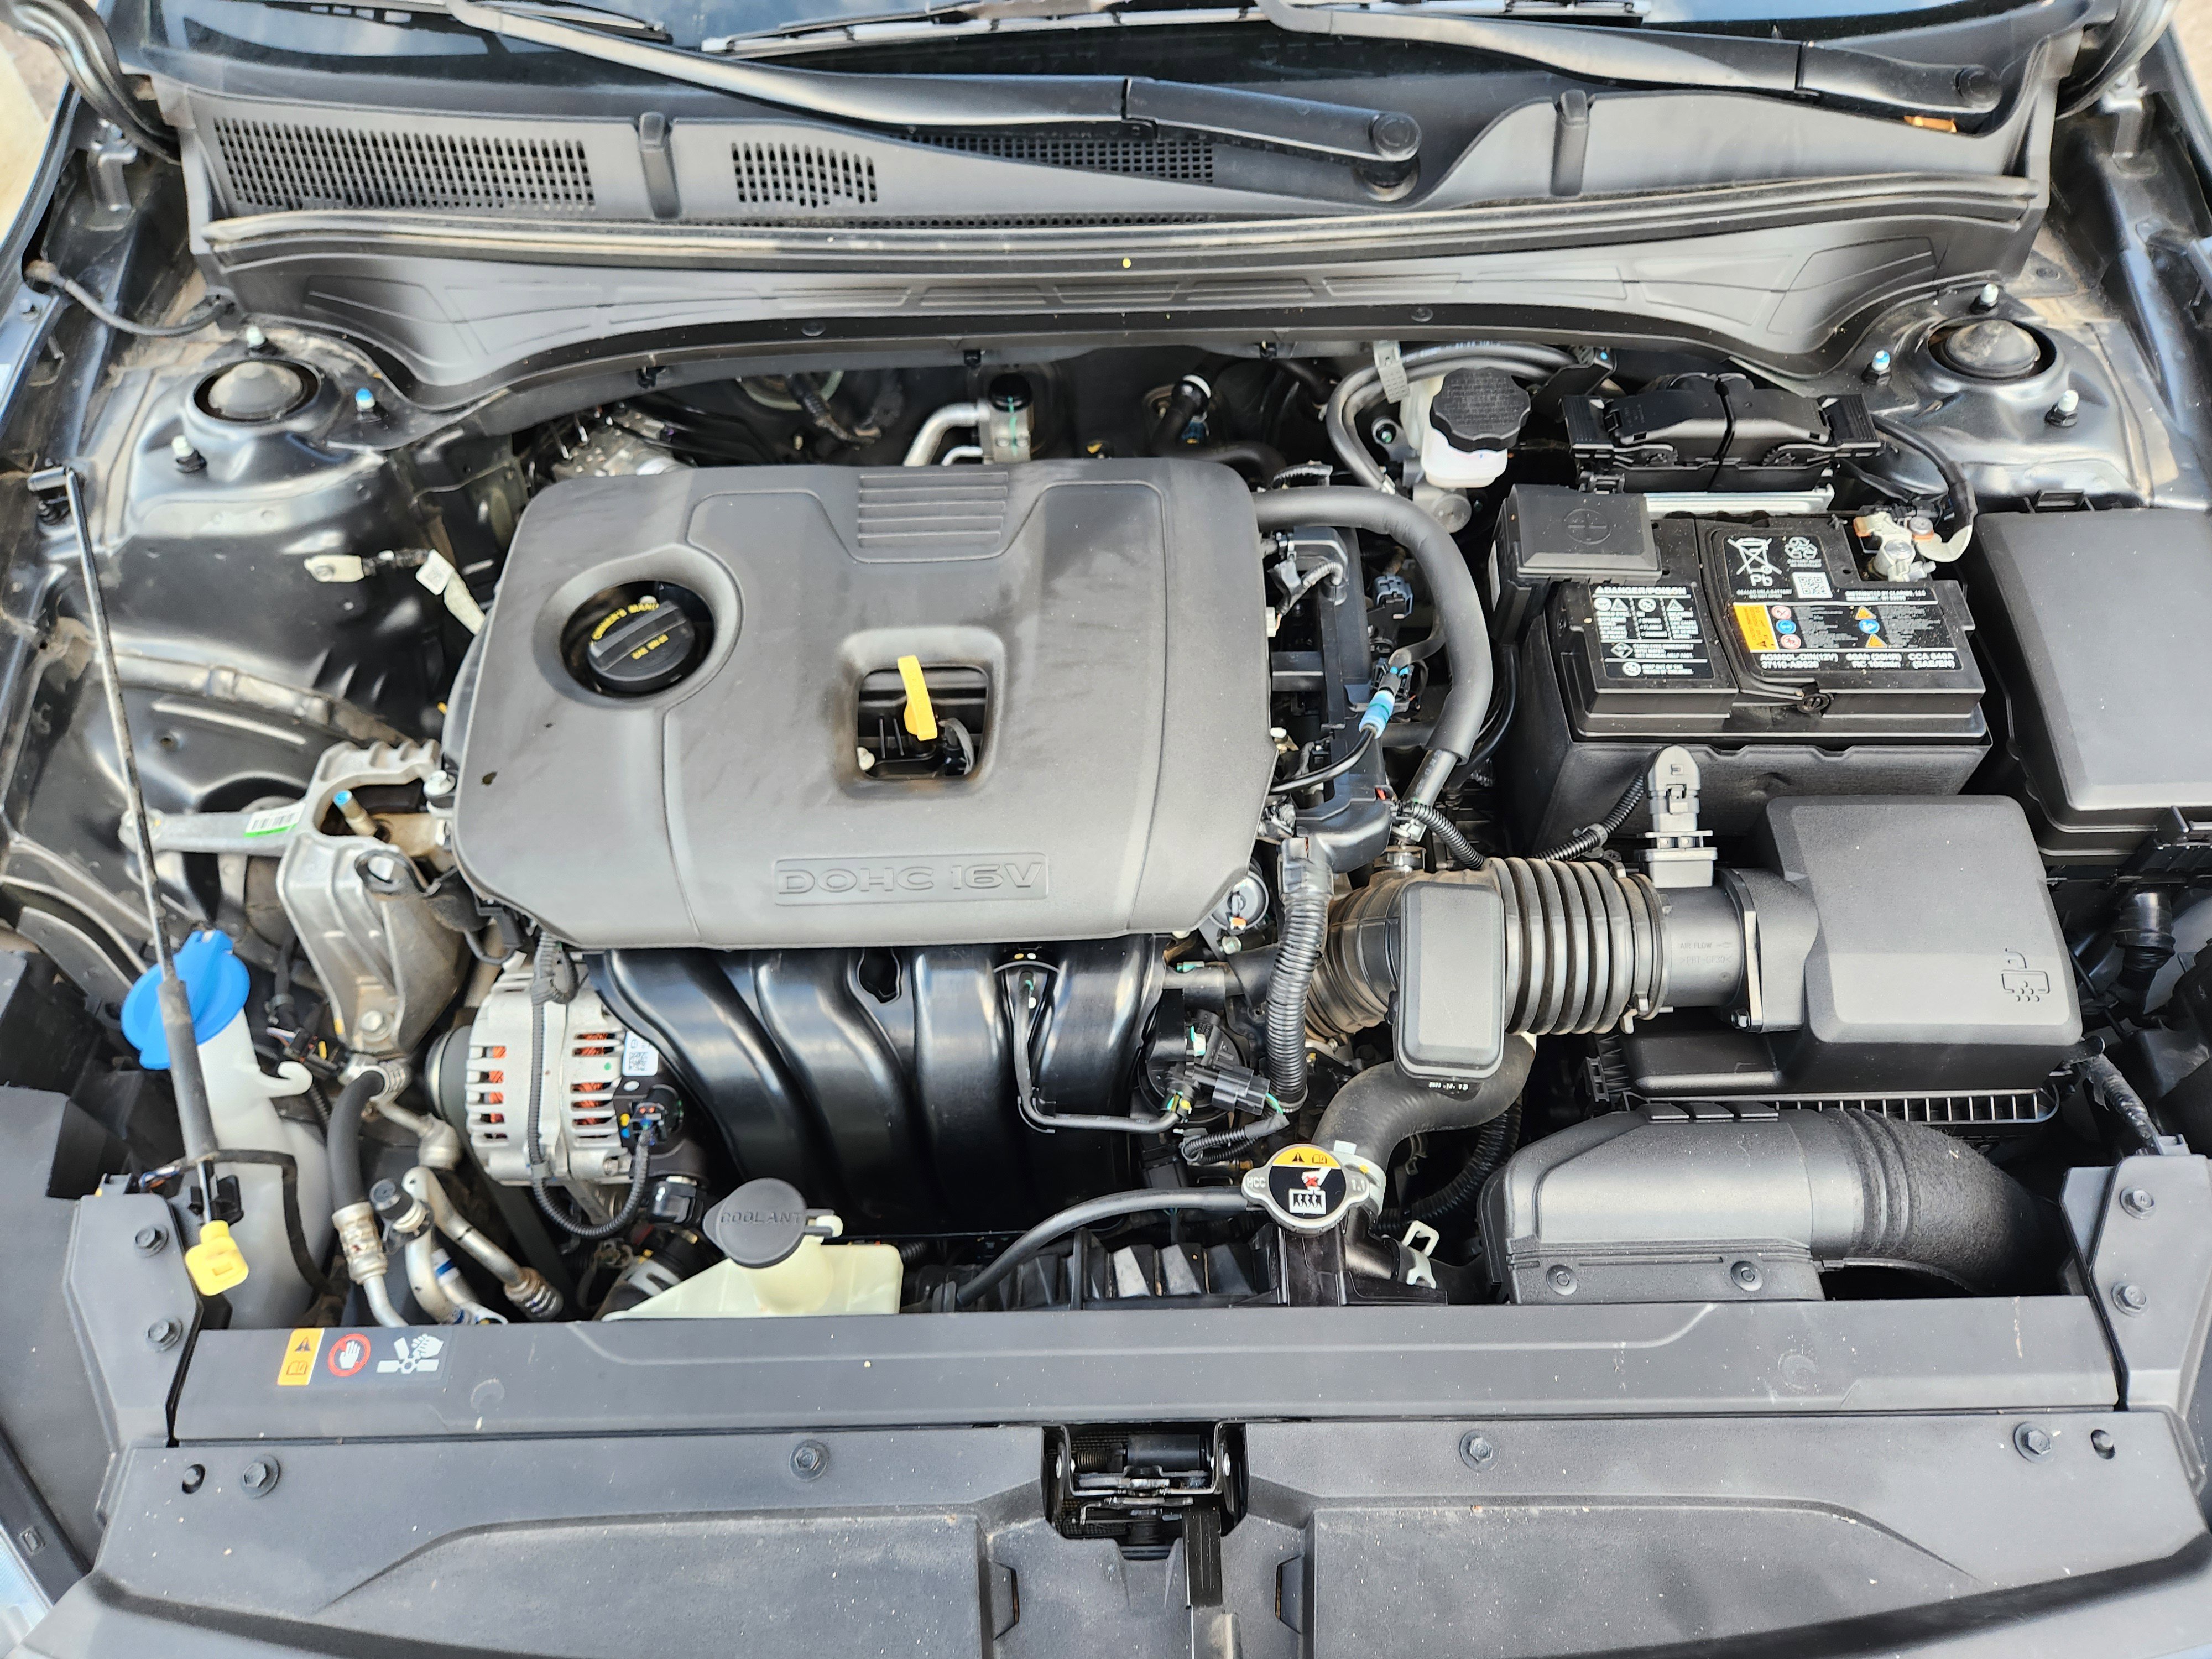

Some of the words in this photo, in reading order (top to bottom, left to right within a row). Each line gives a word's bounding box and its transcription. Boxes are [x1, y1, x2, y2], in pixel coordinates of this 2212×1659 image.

[1750, 573, 1773, 587] Pb
[1604, 587, 1687, 595] DANGER/POISON
[1845, 653, 1870, 661] 60Ah
[1870, 653, 1902, 662] (20HR)
[1908, 653, 1929, 661] CCA
[1930, 652, 1954, 660] 640A
[1867, 660, 1901, 669] 100min
[1912, 660, 1955, 669] (SAE/EN)
[778, 865, 935, 894] DOHC
[950, 862, 1042, 890] 16V
[1245, 1176, 1266, 1188] HCC
[1351, 1178, 1365, 1191] 1.1
[721, 1211, 800, 1224] COOLANT
